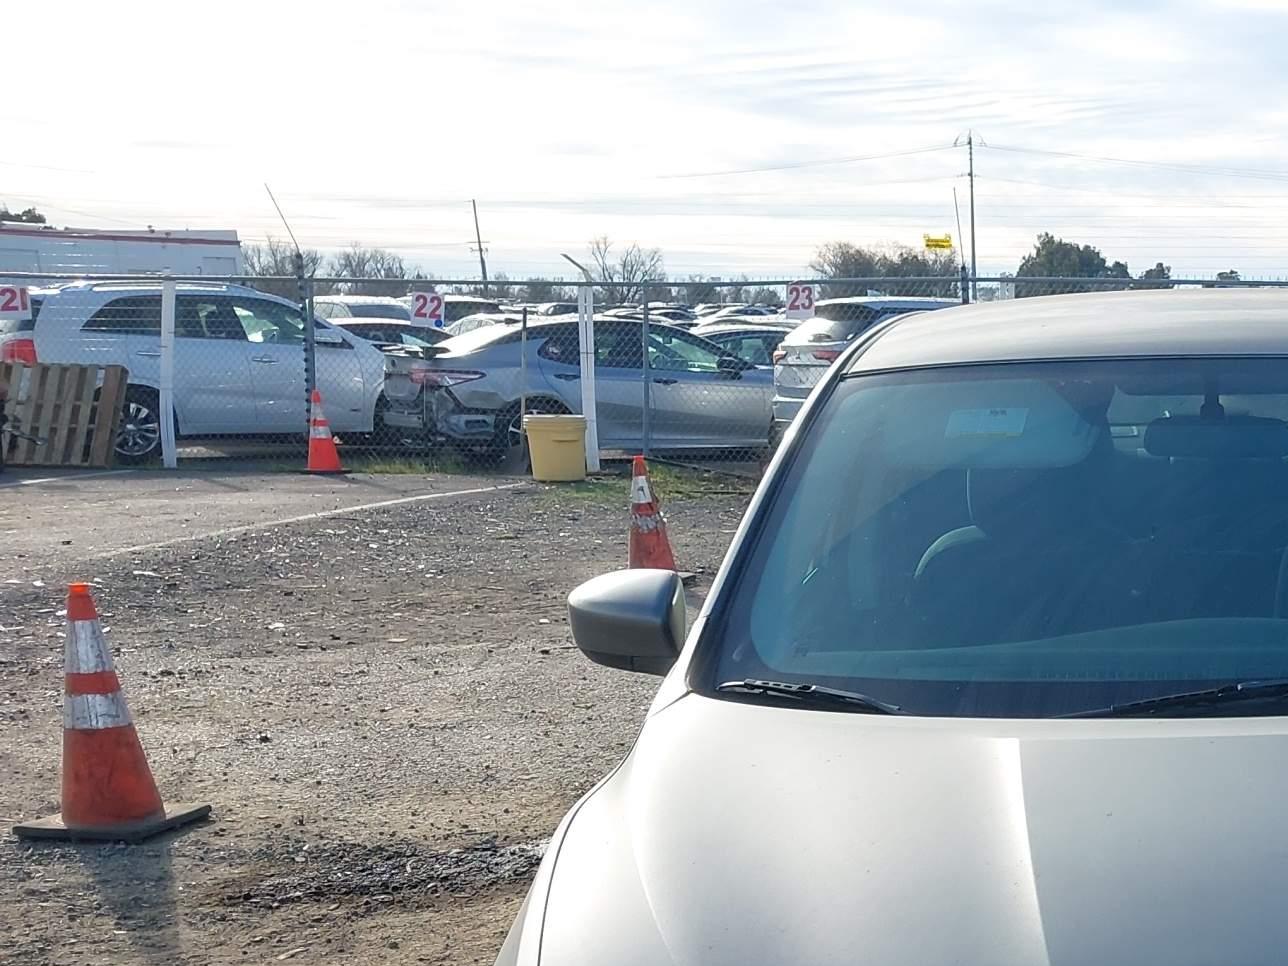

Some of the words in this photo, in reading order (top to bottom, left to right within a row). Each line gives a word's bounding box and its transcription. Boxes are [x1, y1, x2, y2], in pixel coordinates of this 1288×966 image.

[0, 287, 28, 311] 21
[414, 294, 442, 318] 22
[788, 286, 813, 310] 23
